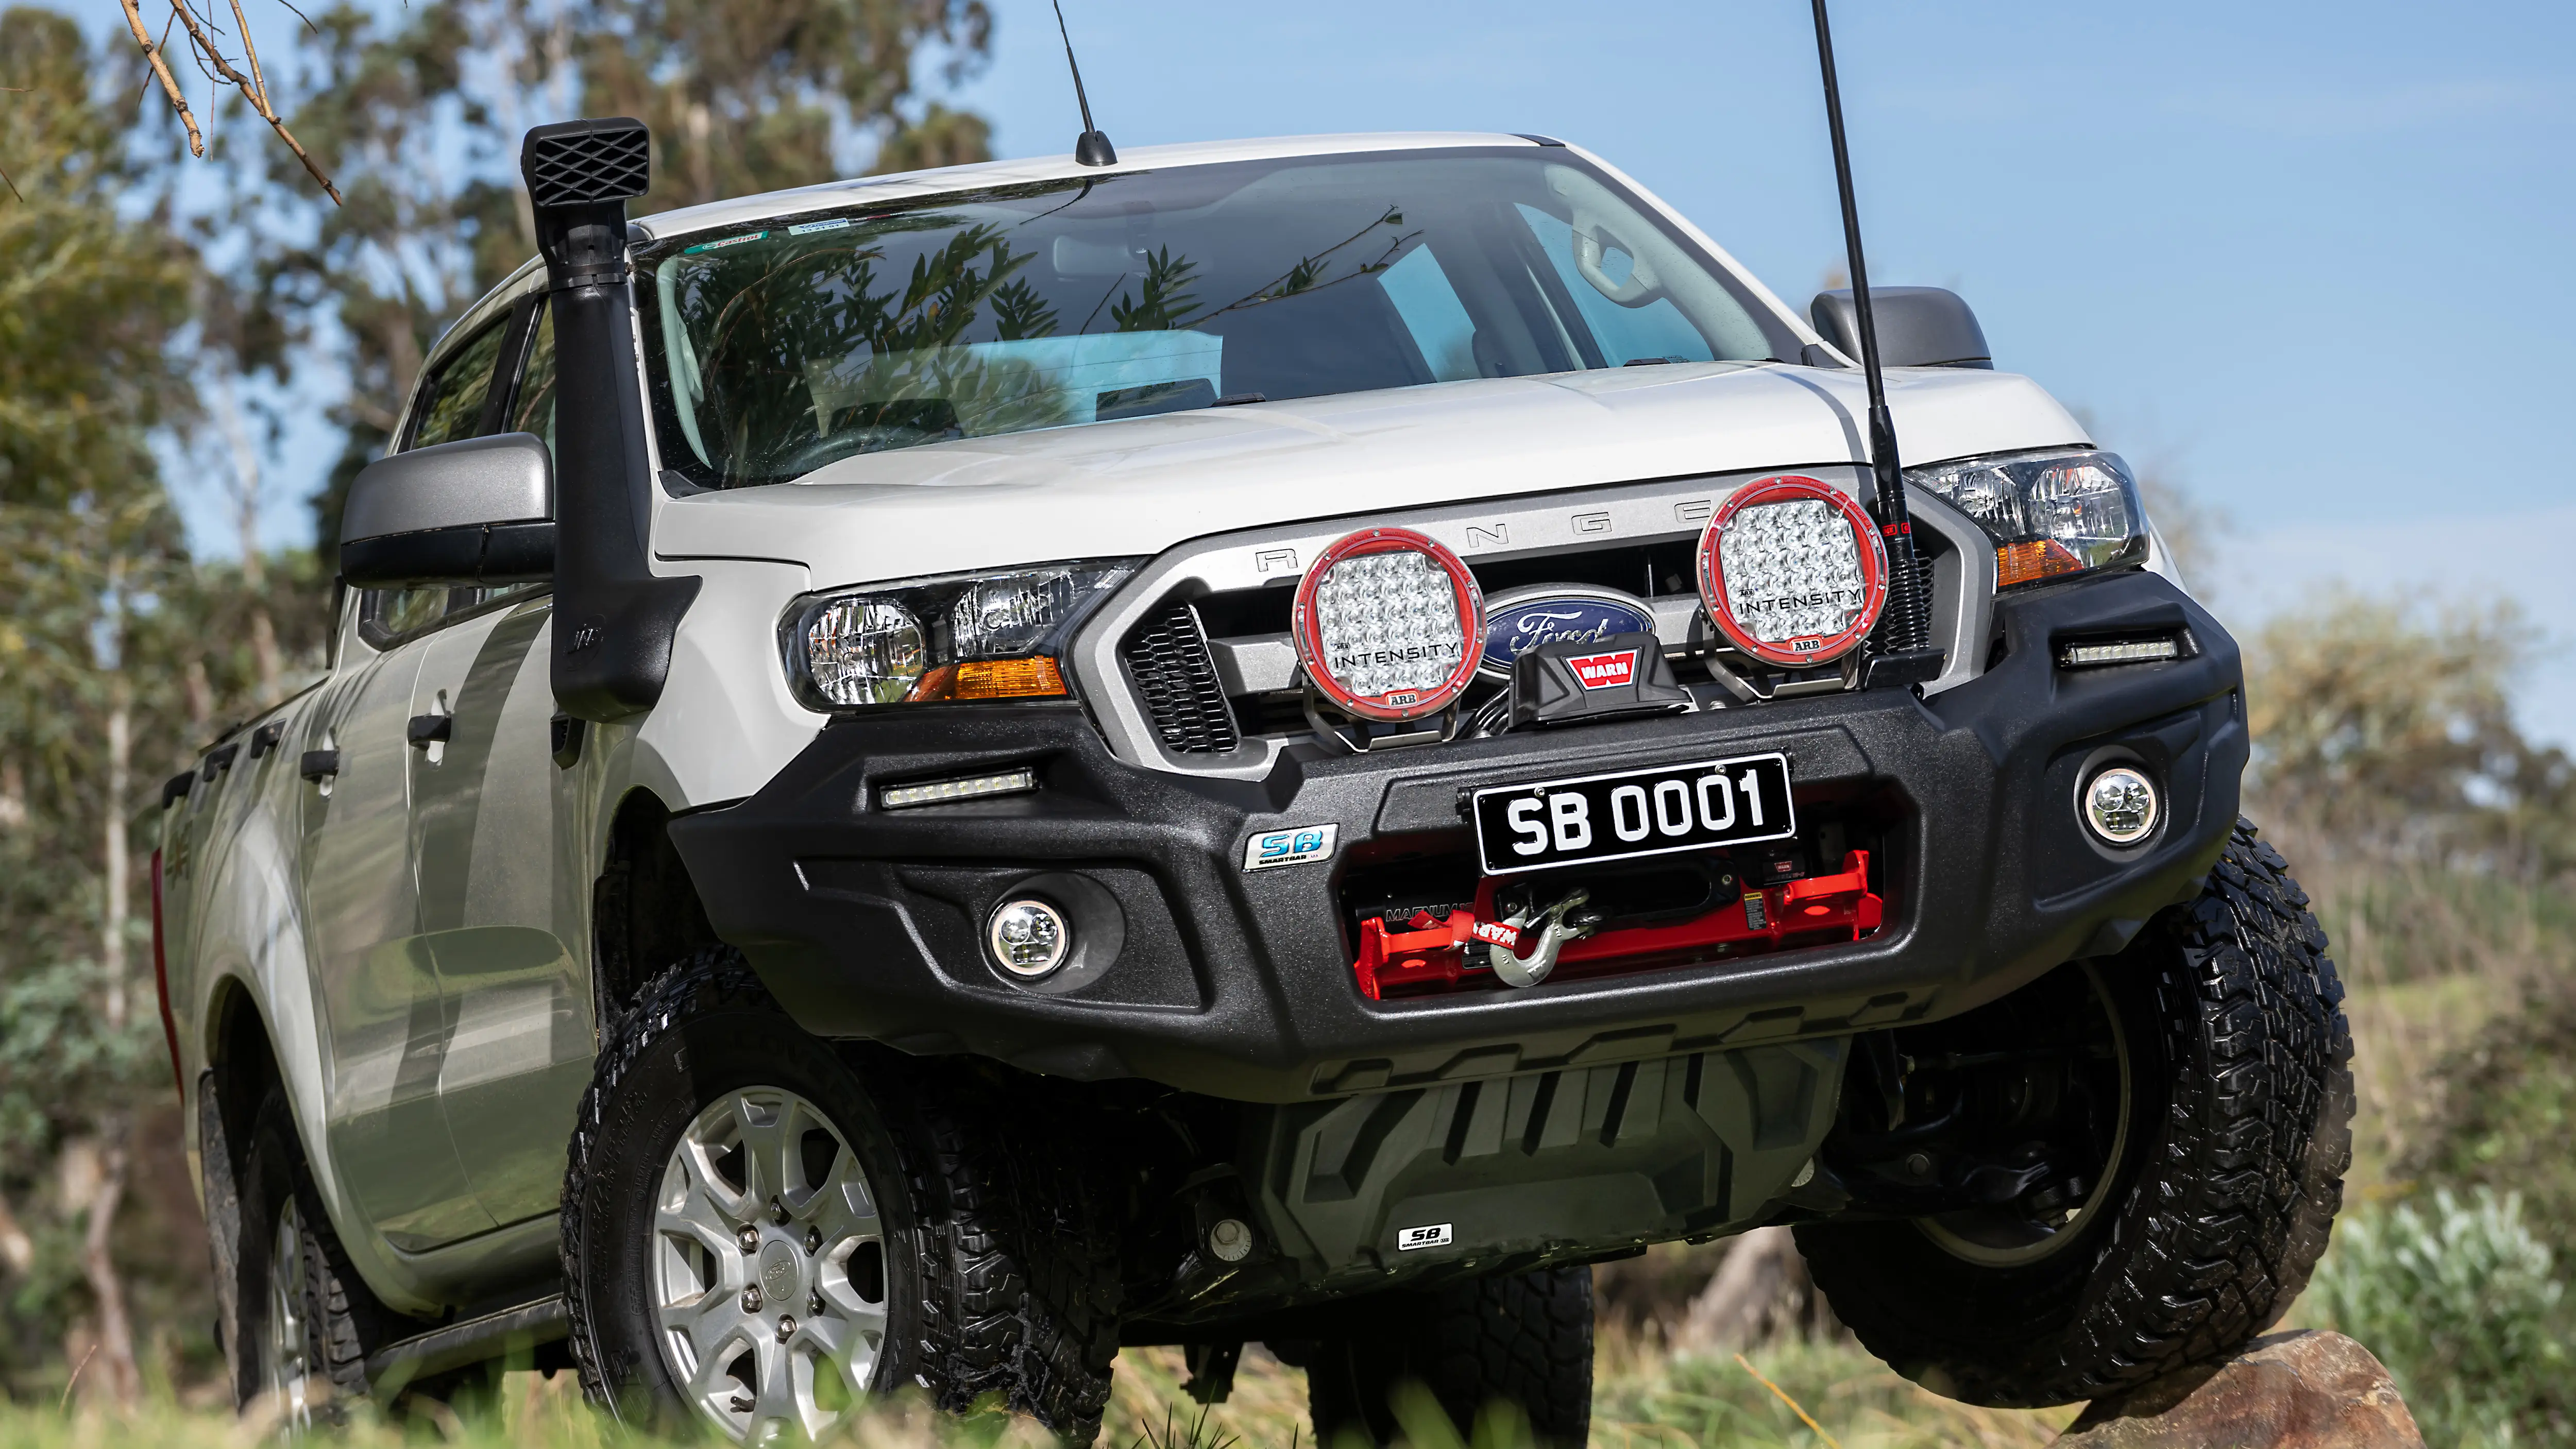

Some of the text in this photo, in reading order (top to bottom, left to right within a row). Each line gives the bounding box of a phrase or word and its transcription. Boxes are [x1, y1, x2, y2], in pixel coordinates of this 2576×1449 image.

[717, 233, 759, 247] Castrol
[1739, 588, 1861, 615] INTENSITY
[1510, 611, 1608, 656] Ford
[1794, 640, 1820, 652] ARB
[1334, 642, 1458, 669] INTENSITY
[1581, 662, 1629, 679] WARN
[1391, 694, 1417, 706] ARB
[1507, 769, 1764, 856] SB 0001
[1259, 830, 1324, 859] SB
[1258, 855, 1307, 865] SMARTBAR
[1411, 1227, 1442, 1242] SB
[1401, 1239, 1439, 1248] SMARTBAR
